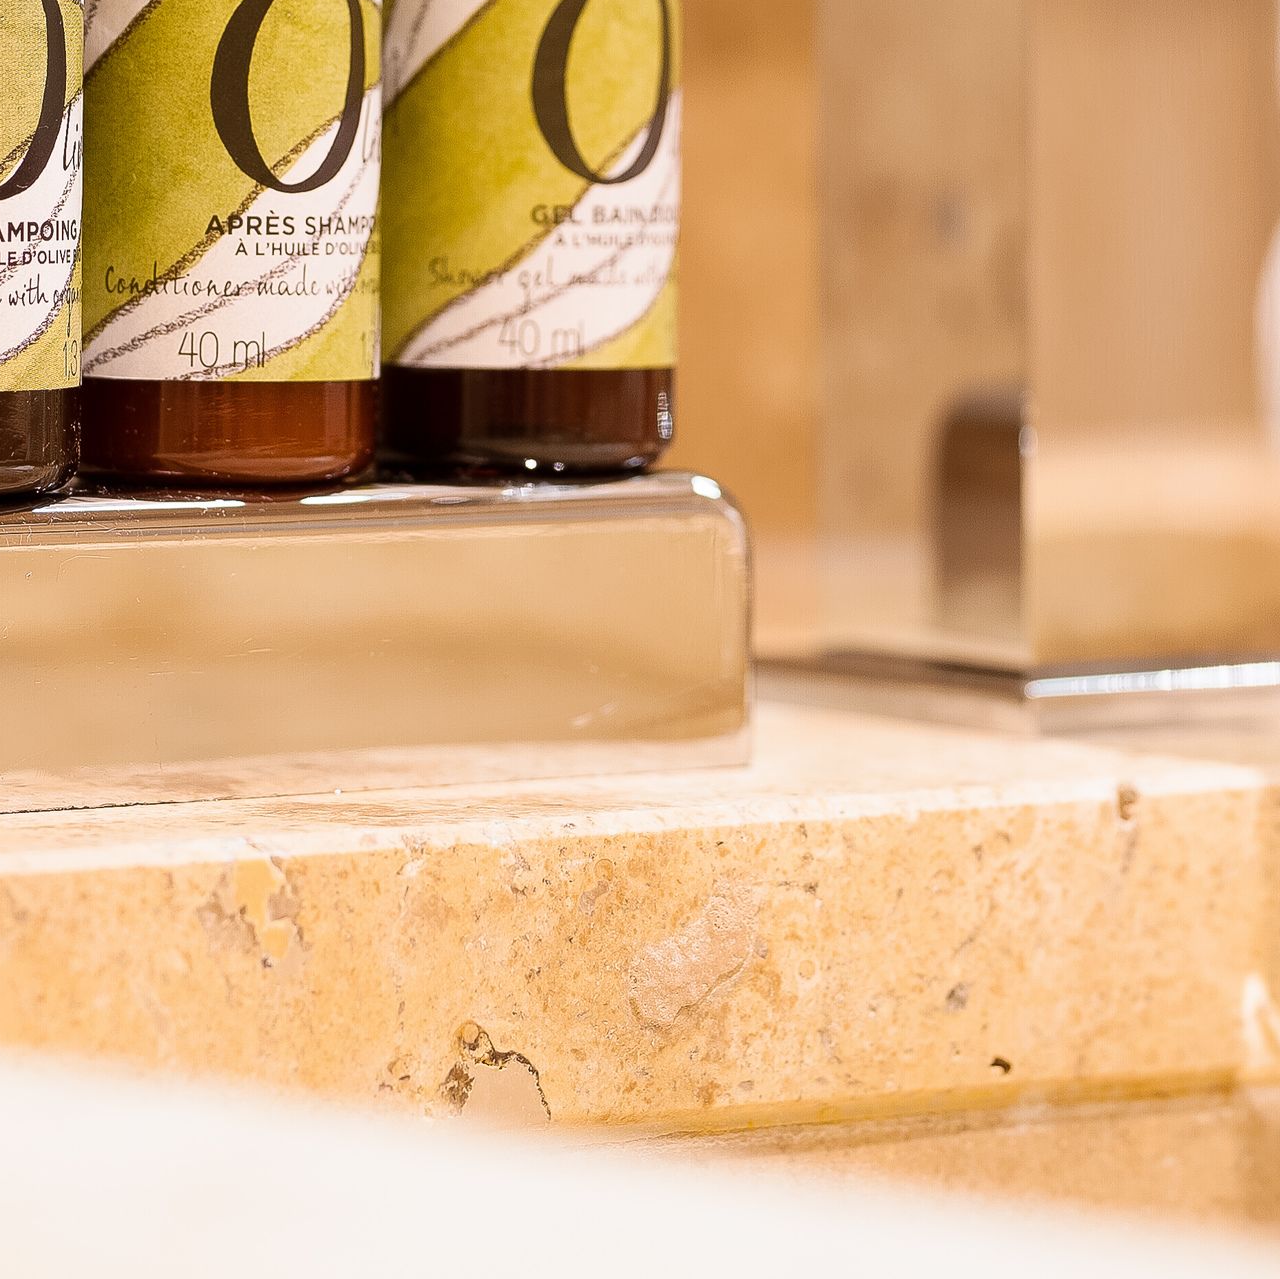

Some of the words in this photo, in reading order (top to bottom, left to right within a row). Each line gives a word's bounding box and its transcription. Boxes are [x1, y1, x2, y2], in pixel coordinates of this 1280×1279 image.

[205, 210, 295, 235] APRÈS
[530, 204, 582, 225] GEL
[22, 250, 71, 265] D'OLIVE
[235, 238, 248, 256] À
[255, 242, 320, 256] L'HUILE
[8, 273, 49, 308] with
[105, 260, 248, 297] Conditioner
[257, 263, 320, 297] made
[178, 330, 219, 368] 40
[233, 331, 265, 368] ml
[498, 319, 541, 357] 40
[551, 321, 585, 357] ml
